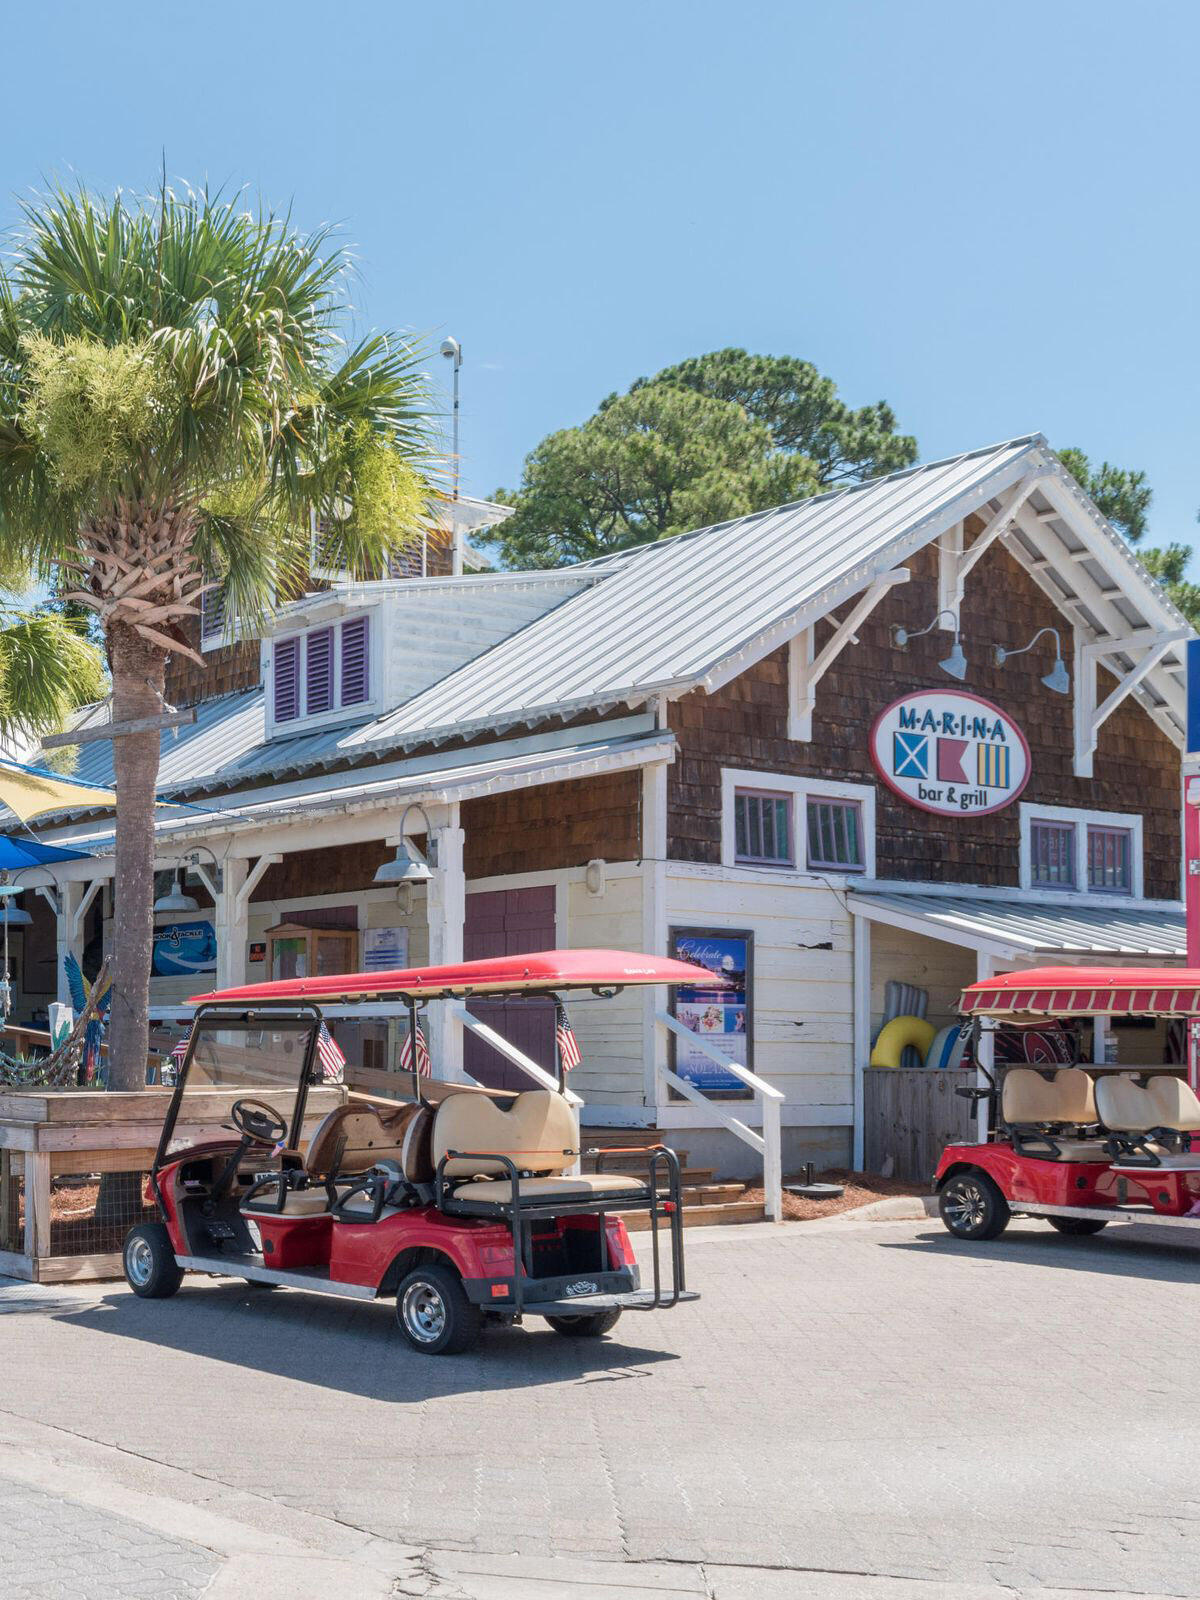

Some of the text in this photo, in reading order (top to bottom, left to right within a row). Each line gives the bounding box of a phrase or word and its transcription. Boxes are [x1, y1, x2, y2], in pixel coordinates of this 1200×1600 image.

[918, 783, 987, 810] bar & grill
[179, 930, 203, 938] TACKLE
